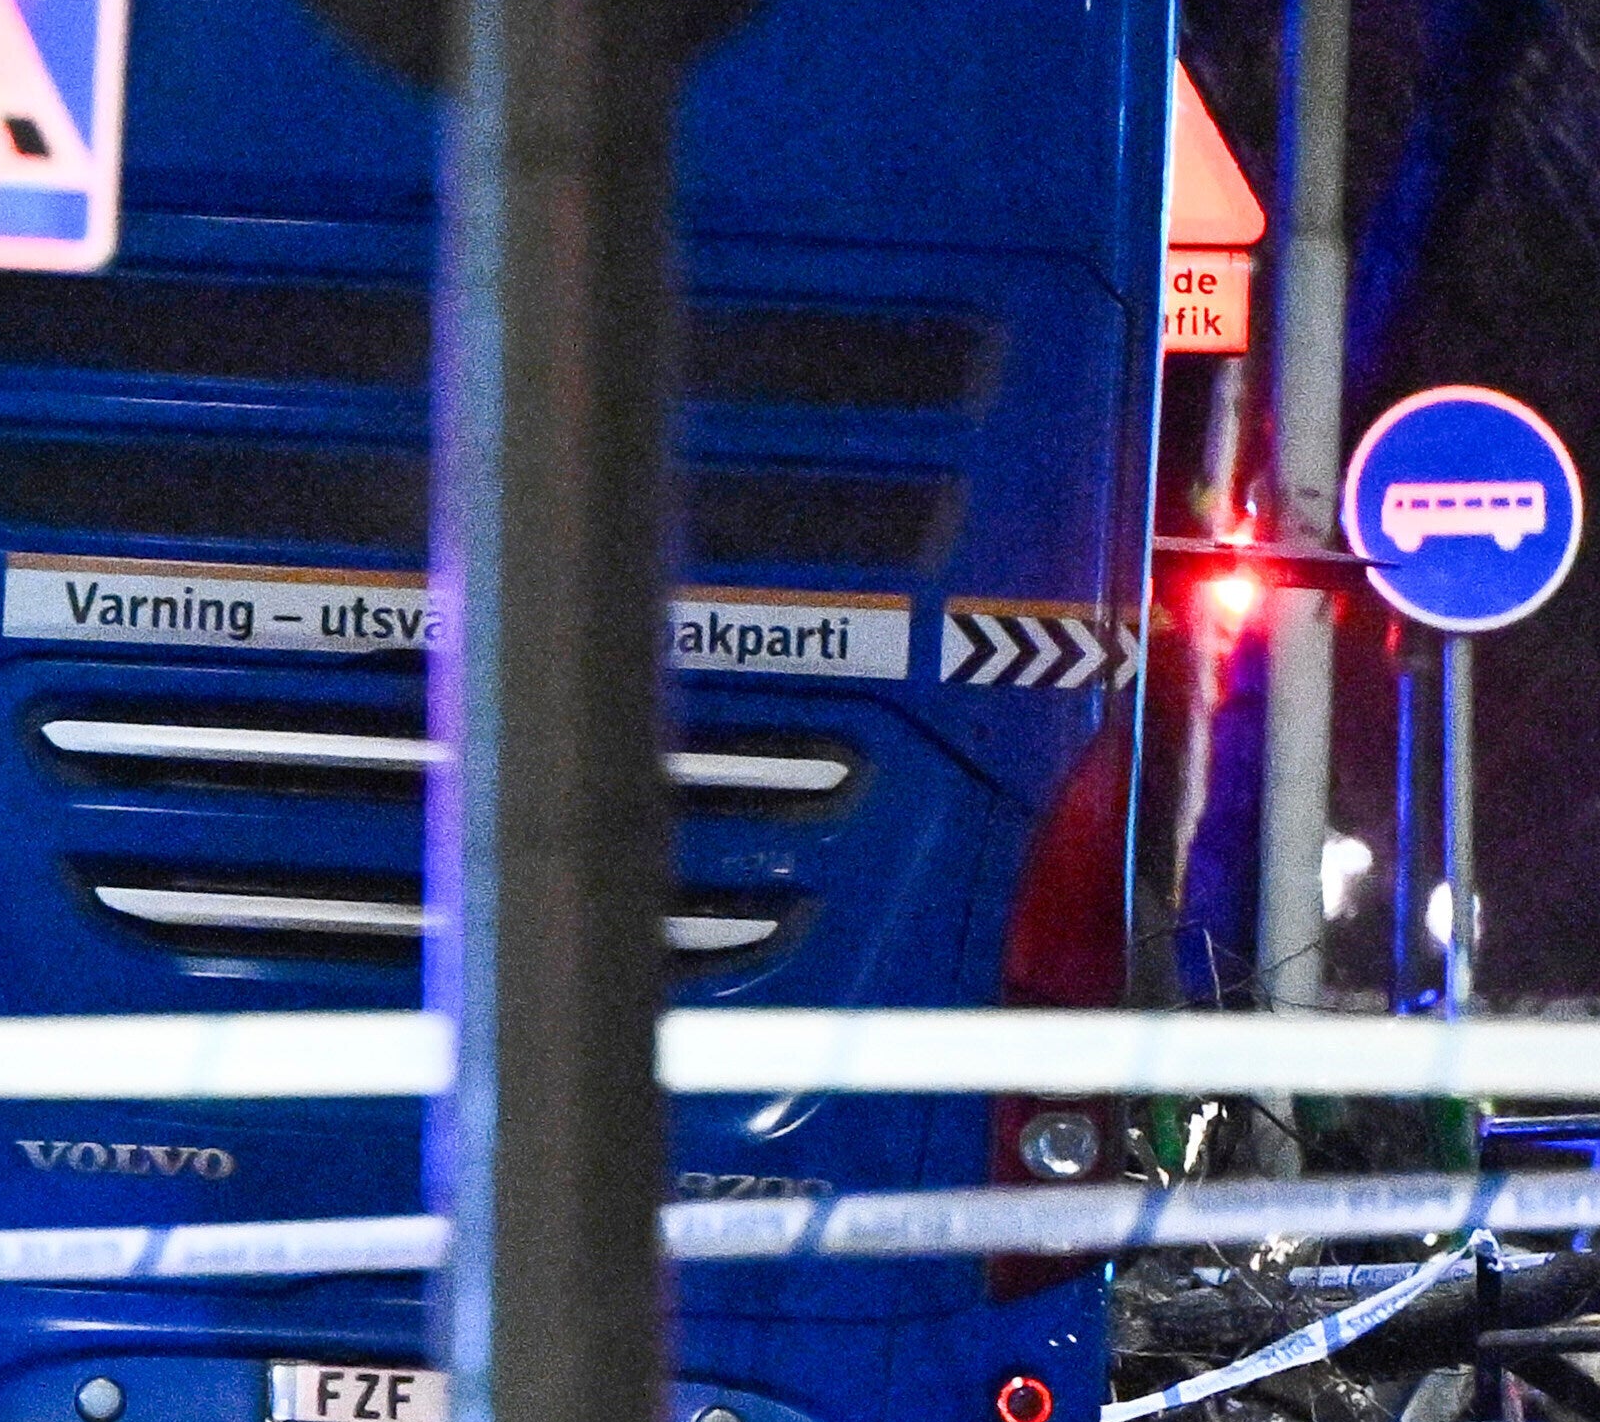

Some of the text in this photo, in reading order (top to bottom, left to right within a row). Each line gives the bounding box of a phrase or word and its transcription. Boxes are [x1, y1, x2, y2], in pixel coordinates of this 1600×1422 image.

[1173, 268, 1218, 295] de
[1164, 306, 1222, 336] fik
[65, 581, 255, 642] Varning
[665, 611, 850, 665] akparti
[15, 1139, 236, 1179] VOLVO
[317, 1371, 416, 1421] FZF
